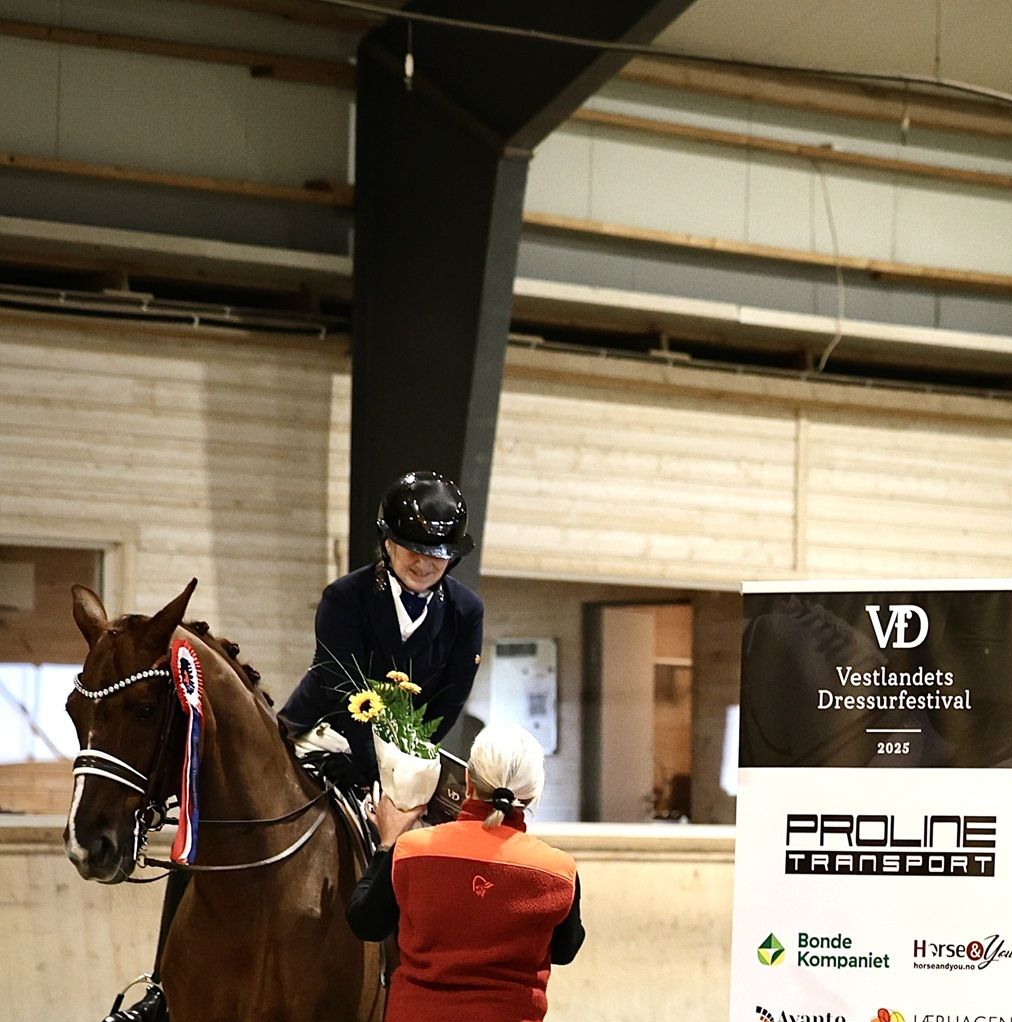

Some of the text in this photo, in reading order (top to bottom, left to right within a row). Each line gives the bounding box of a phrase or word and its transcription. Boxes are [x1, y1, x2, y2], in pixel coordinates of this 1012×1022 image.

[836, 667, 953, 686] Vestlandets
[818, 690, 971, 709] Dressurfestival
[878, 742, 909, 753] 2025
[786, 814, 996, 848] PROLINE
[788, 854, 993, 873] TRANSPORT
[799, 933, 852, 949] Bonde
[798, 951, 889, 969] Kompaniet
[913, 962, 976, 972] horseandyou.no
